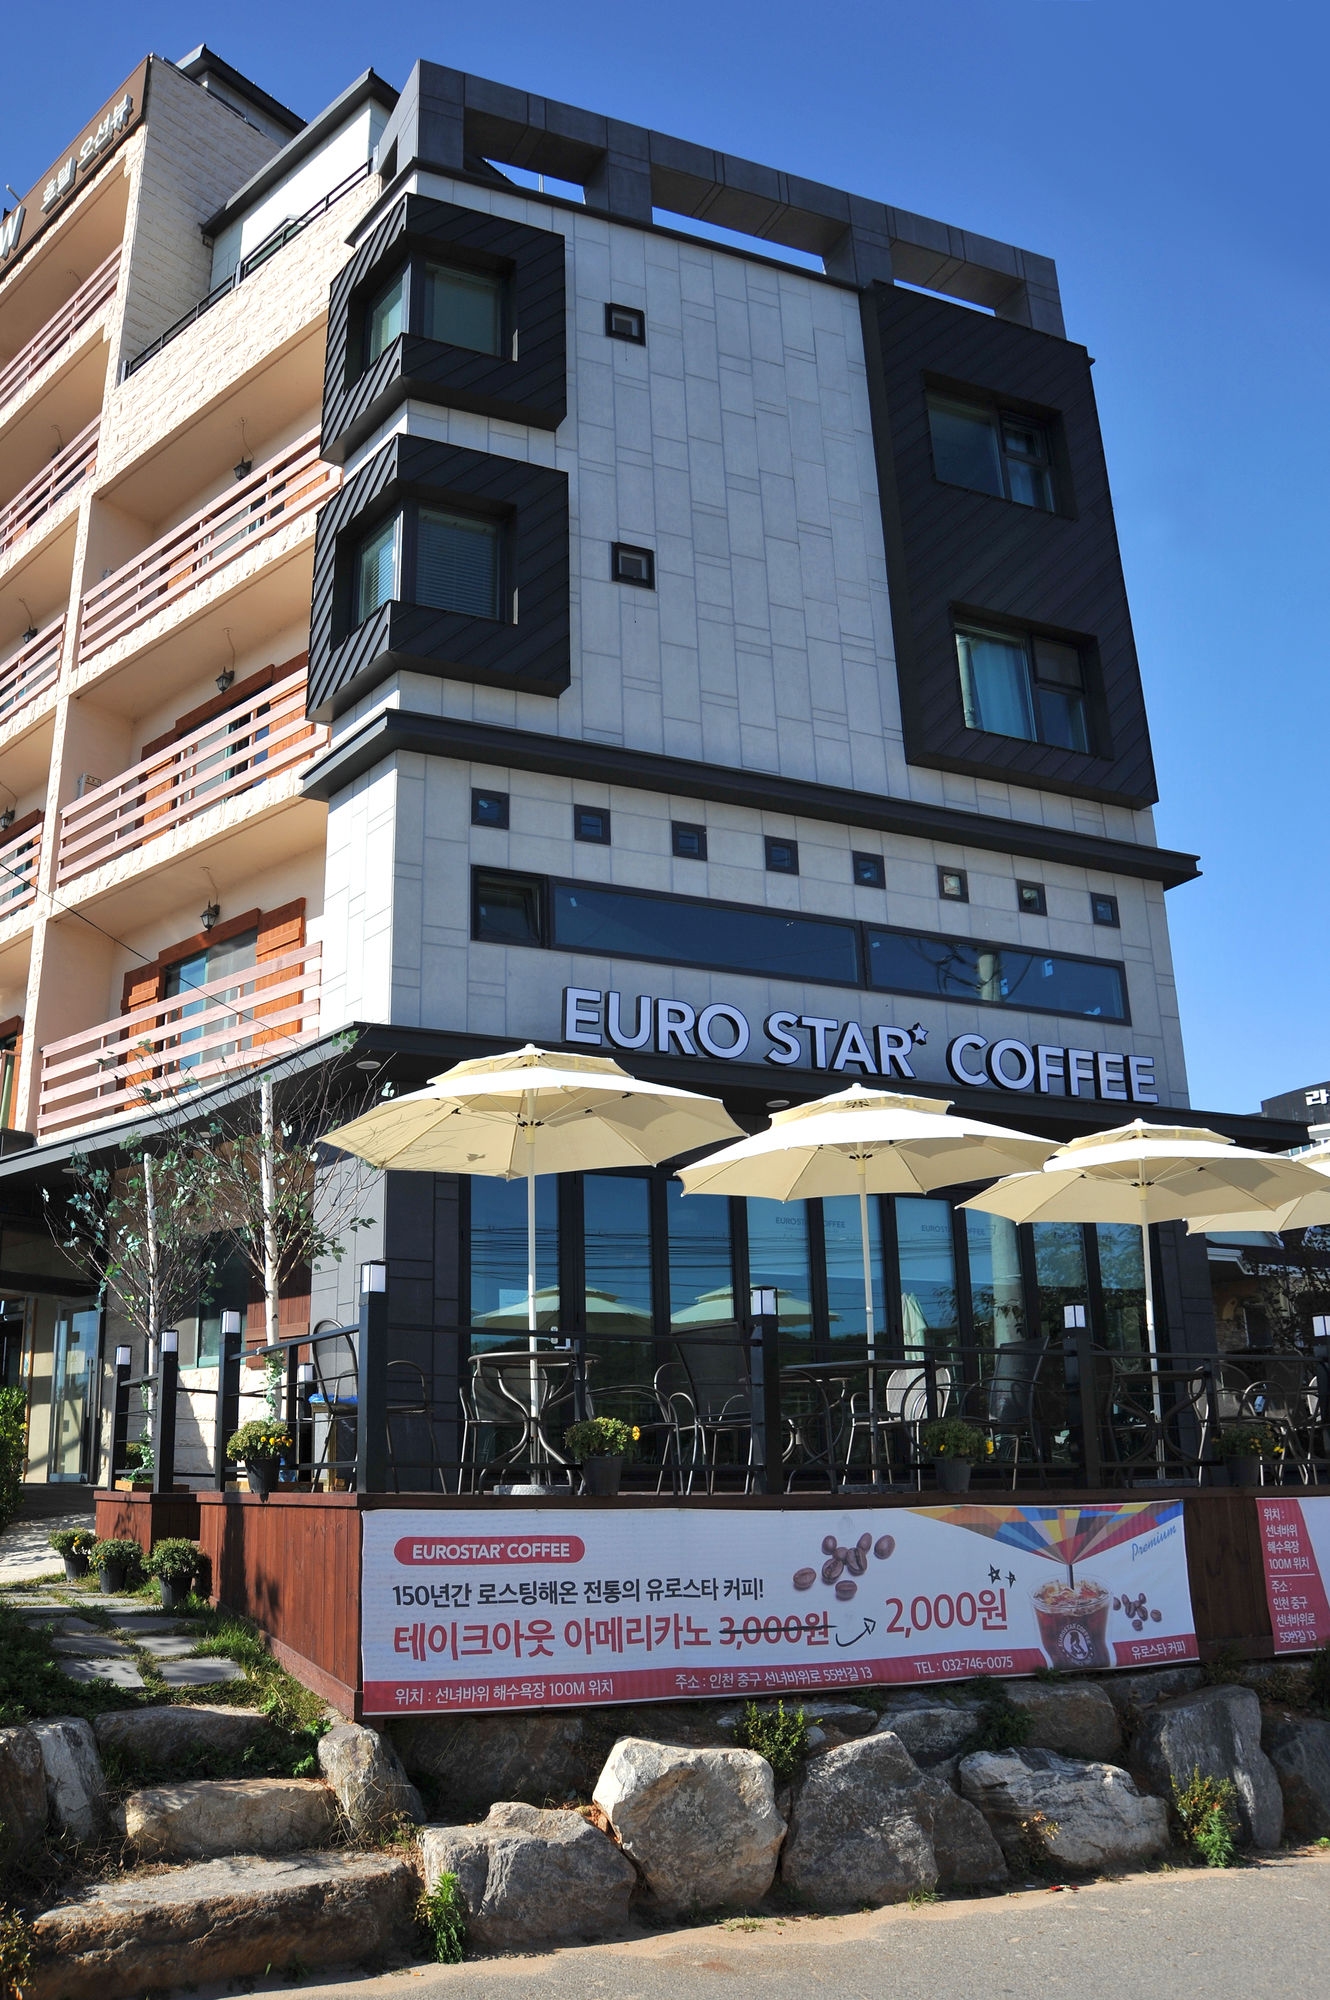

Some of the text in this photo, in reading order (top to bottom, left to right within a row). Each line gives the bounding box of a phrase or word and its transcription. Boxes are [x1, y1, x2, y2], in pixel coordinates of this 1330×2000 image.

[40, 93, 133, 214] 호텔 오션뷰
[562, 986, 750, 1059] EURO
[950, 1033, 1159, 1104] COFFEE
[1263, 1508, 1280, 1521] 위치
[1265, 1524, 1298, 1538] 선녀바위
[507, 1543, 570, 1558] COFFEE
[1132, 1525, 1177, 1561] Premium
[1267, 1540, 1299, 1554] 해수욕장
[1269, 1557, 1309, 1570] 100M 위치
[393, 1577, 763, 1608] 150년간 로스팅해온 전통의 유로스타 커피!
[1271, 1580, 1288, 1593] 주소
[1273, 1596, 1308, 1610] 인천 중구
[394, 1588, 1008, 1661] 테이크아웃 아메리카노 3,000원 2,000원
[1277, 1612, 1316, 1627] 선녀바위로
[1280, 1630, 1317, 1643] 55번길 13
[1132, 1640, 1186, 1660] 유로스타 커피
[914, 1661, 935, 1674] TEL
[942, 1656, 1014, 1672] 032-746-0075
[675, 1674, 700, 1690] 주소
[710, 1672, 734, 1688] 인천
[737, 1672, 761, 1689] 중구
[764, 1669, 821, 1687] 선녀바위로
[823, 1667, 859, 1683] 55번길
[860, 1667, 873, 1679] 13
[395, 1688, 423, 1705] 위치
[435, 1685, 490, 1704] 선녀바위
[493, 1681, 546, 1701] 해수욕장
[549, 1681, 585, 1697] 100M
[588, 1678, 614, 1696] 위치
